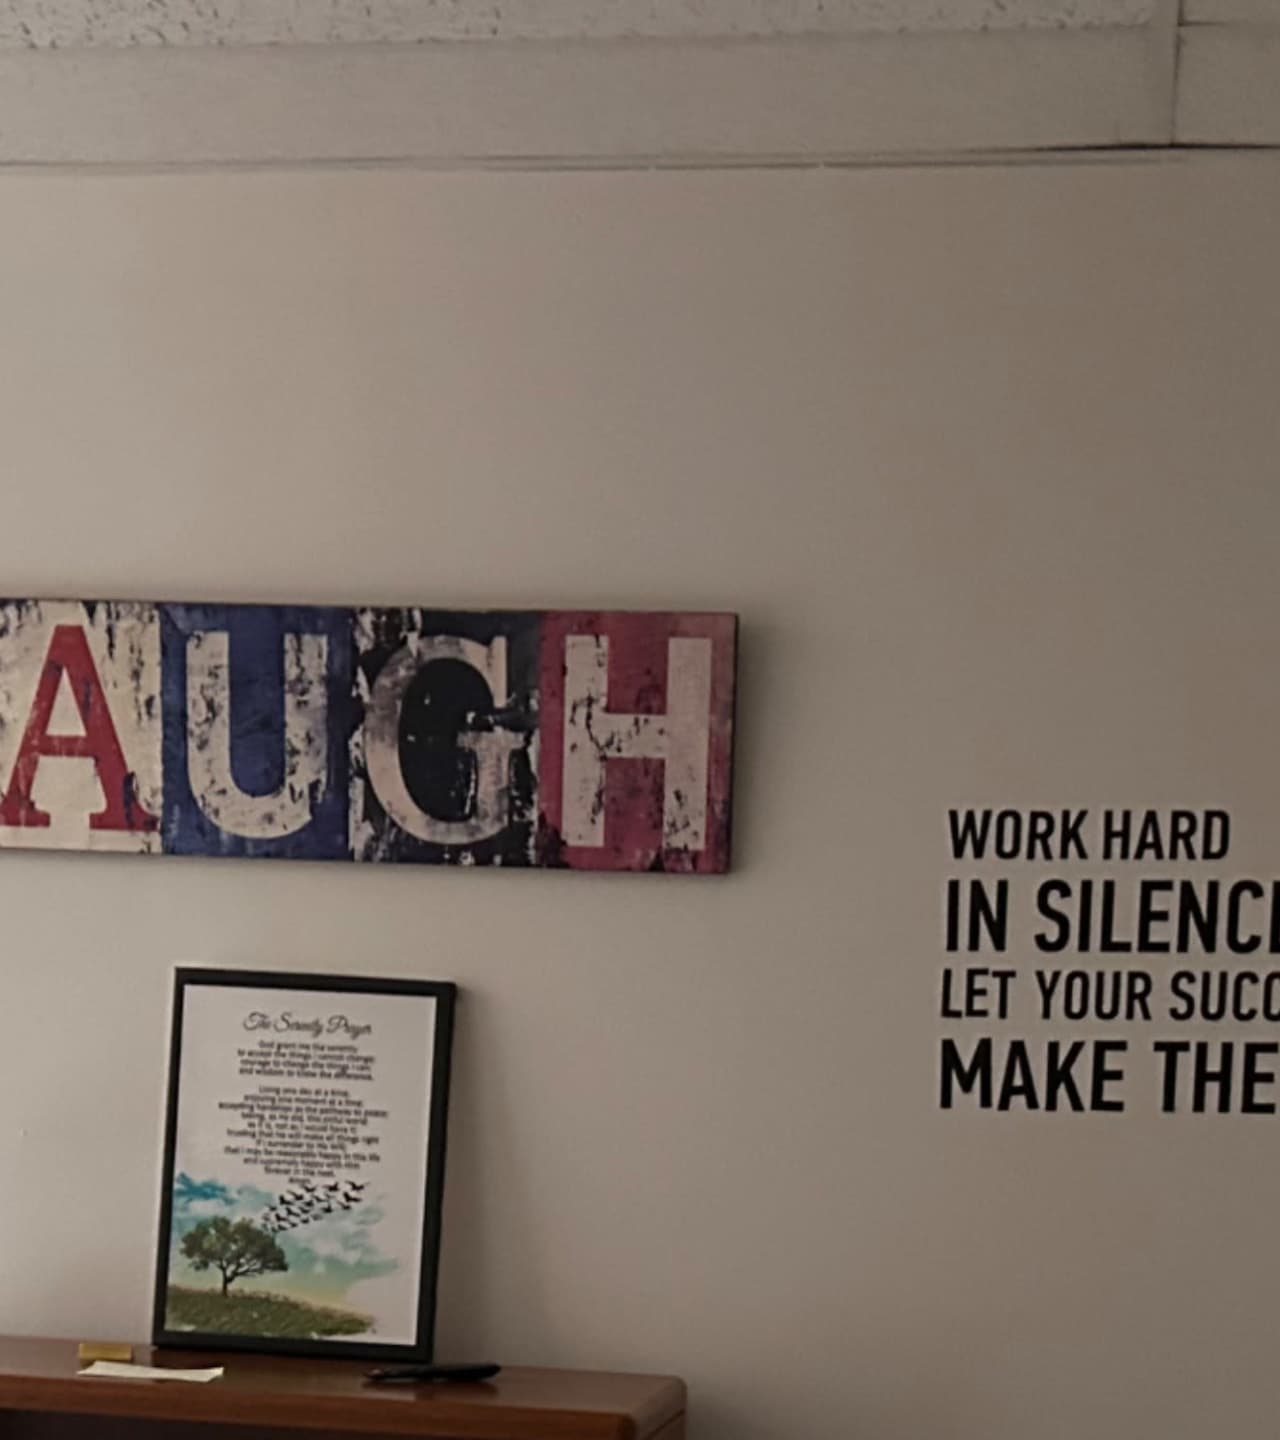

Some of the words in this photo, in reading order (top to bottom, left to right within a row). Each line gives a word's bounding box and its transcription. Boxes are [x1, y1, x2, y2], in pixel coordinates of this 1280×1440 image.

[948, 809, 1089, 861] WORK
[1102, 809, 1231, 861] HARD
[945, 878, 1009, 952] IN
[939, 967, 1017, 1020] LET
[1034, 969, 1153, 1022] YOUR
[939, 1038, 1128, 1113] MAKE
[1153, 1041, 1279, 1115] THE
